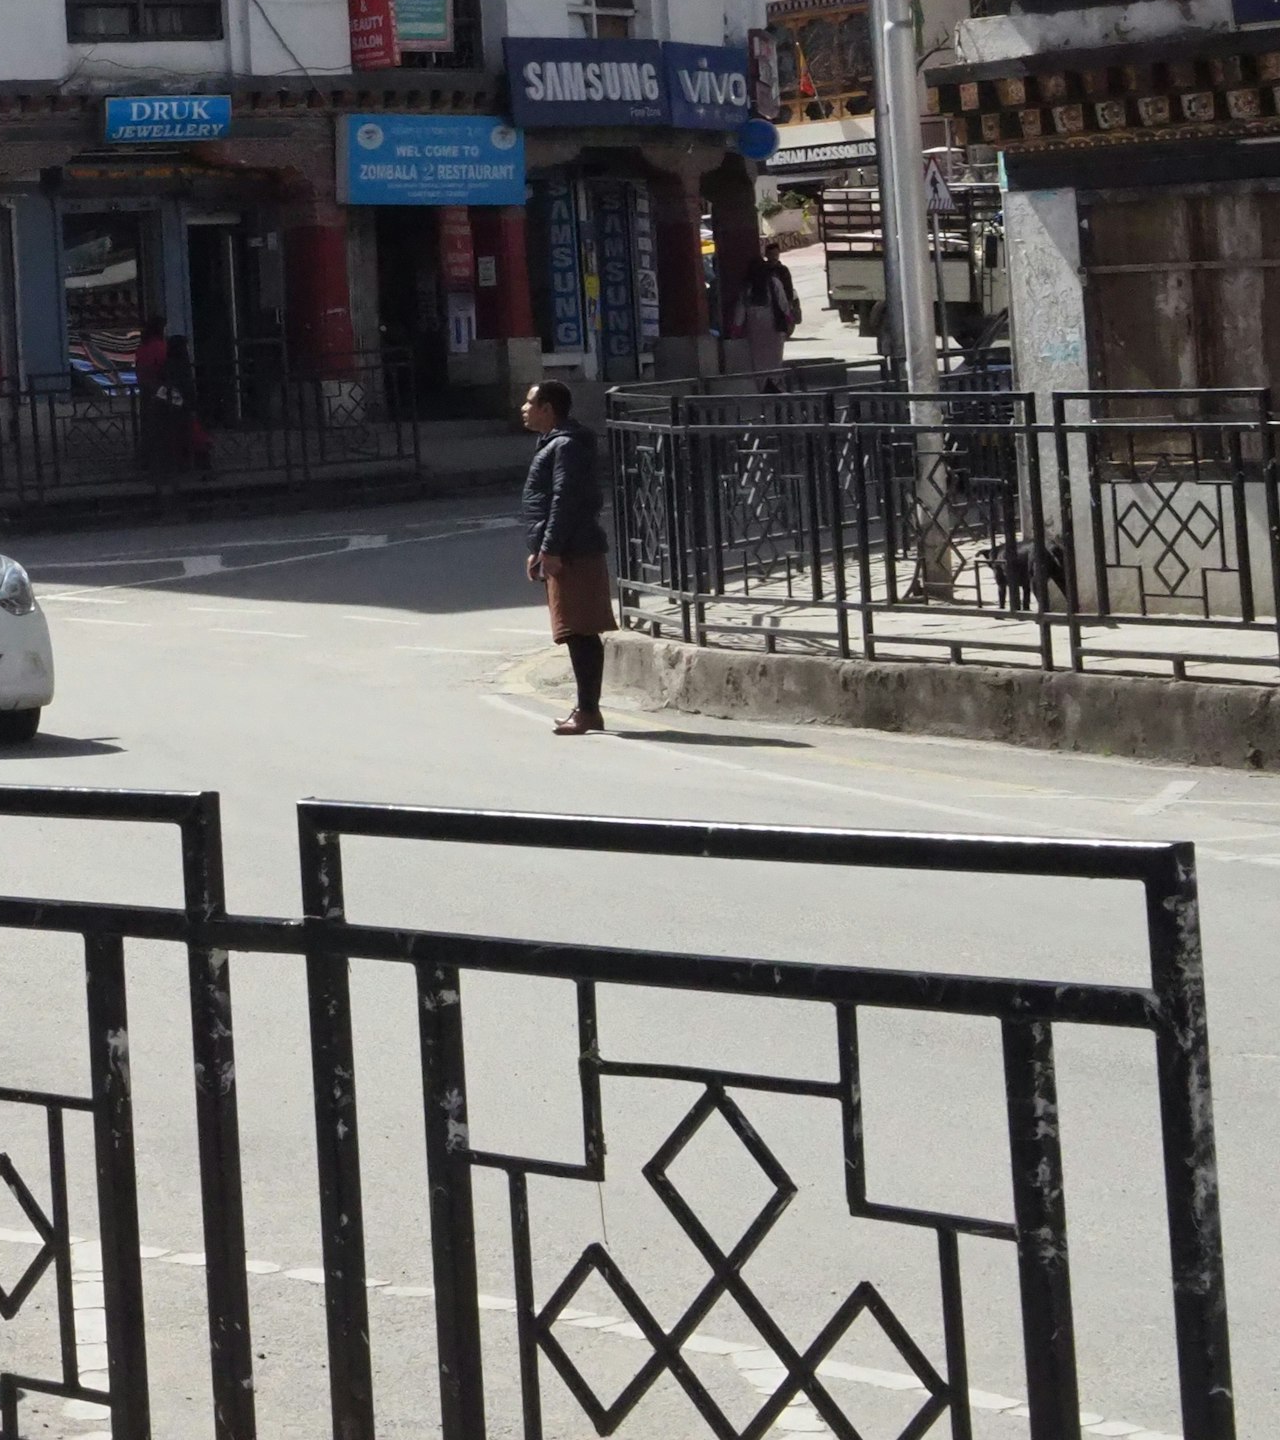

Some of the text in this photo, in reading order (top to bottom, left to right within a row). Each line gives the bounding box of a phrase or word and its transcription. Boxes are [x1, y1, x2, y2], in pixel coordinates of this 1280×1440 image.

[523, 61, 659, 101] SAMSUNG
[130, 100, 211, 122] DRUK
[112, 123, 224, 140] JEWELLERY
[464, 146, 480, 158] TO
[806, 141, 877, 162] ACCESSORIES
[359, 164, 417, 180] ZOMBALA
[438, 164, 516, 180] RESTAURANT
[548, 179, 578, 343] SAMSUNG
[602, 195, 631, 356] SAMSUNG
